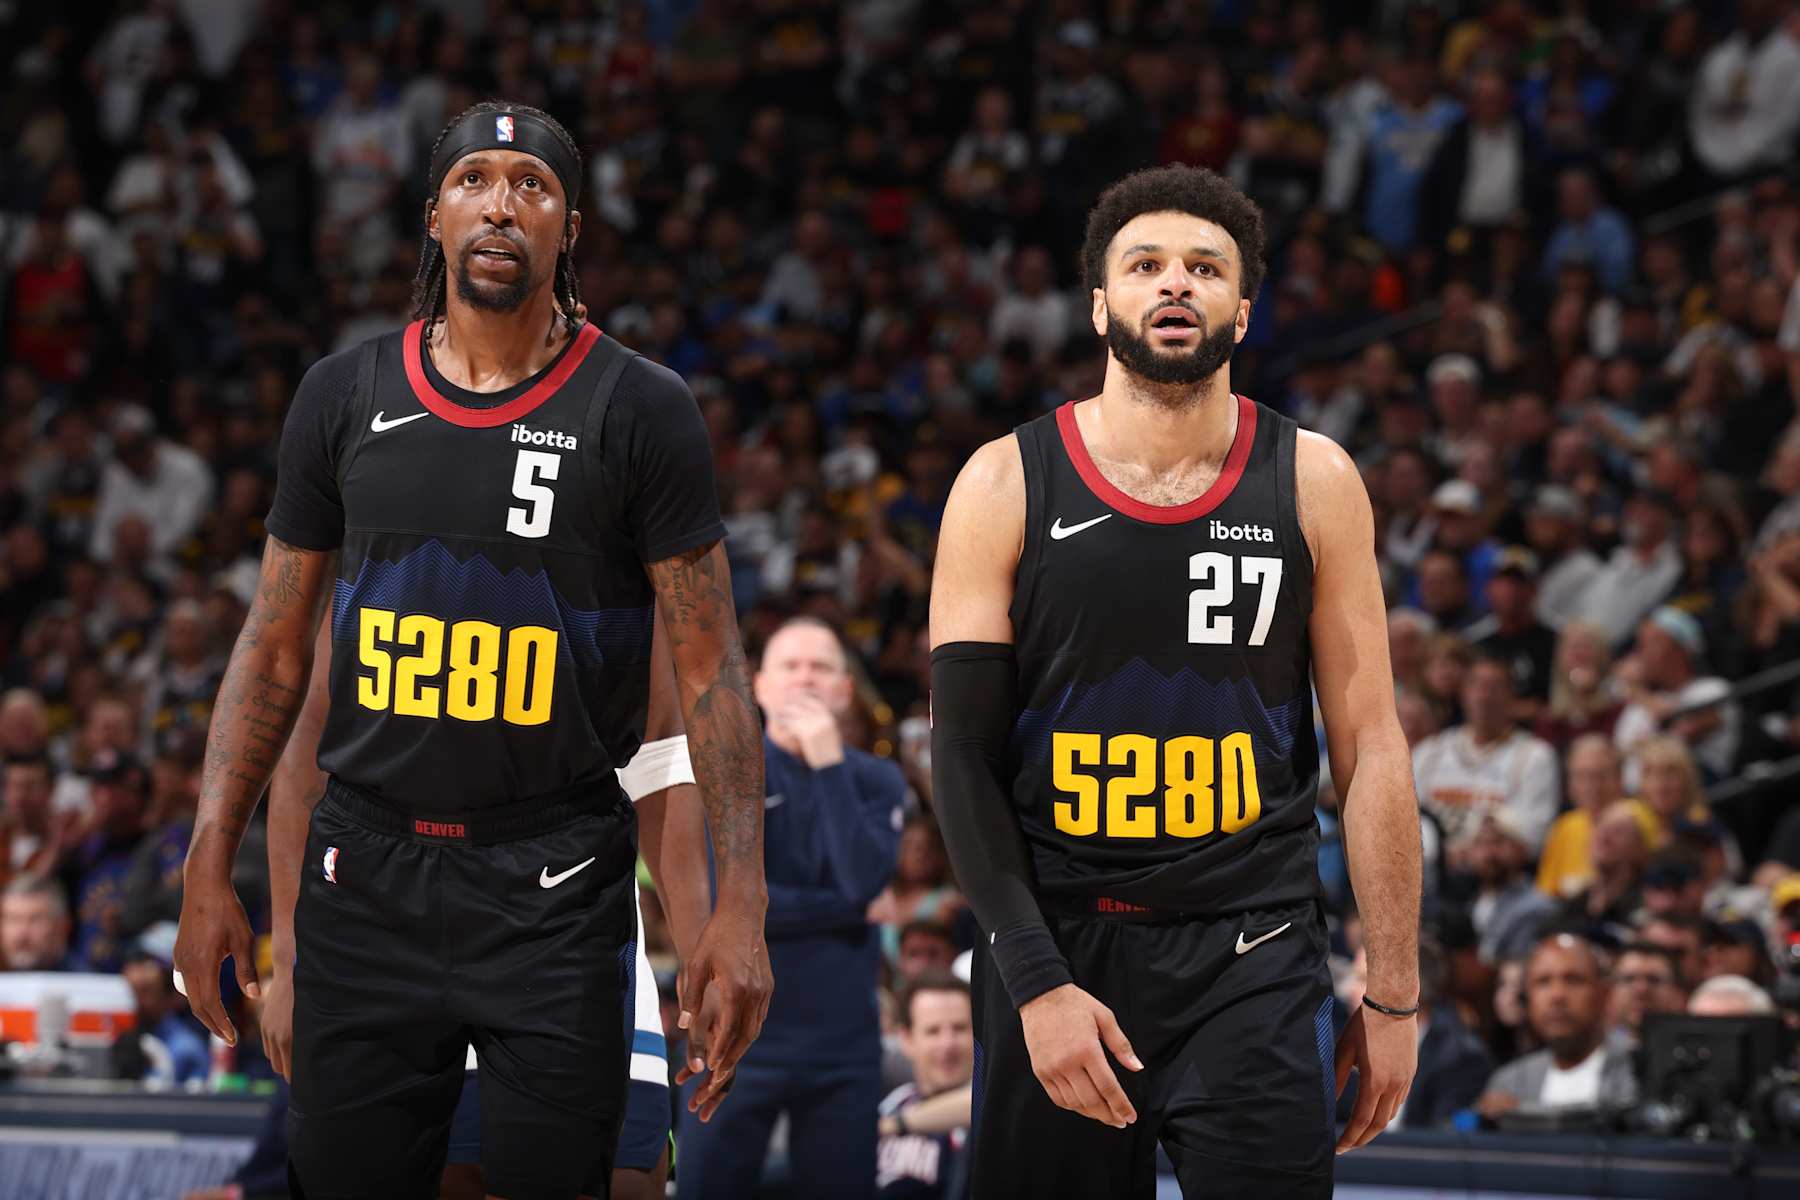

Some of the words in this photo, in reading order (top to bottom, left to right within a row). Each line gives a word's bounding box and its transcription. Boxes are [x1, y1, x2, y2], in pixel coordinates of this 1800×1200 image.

[511, 424, 577, 450] ibotta
[506, 449, 561, 538] 5
[1209, 520, 1274, 542] ibotta
[1188, 552, 1283, 646] 27
[358, 607, 559, 726] 5280
[1052, 731, 1261, 839] 5280
[415, 819, 465, 838] DENVER
[1098, 897, 1152, 913] DEN
